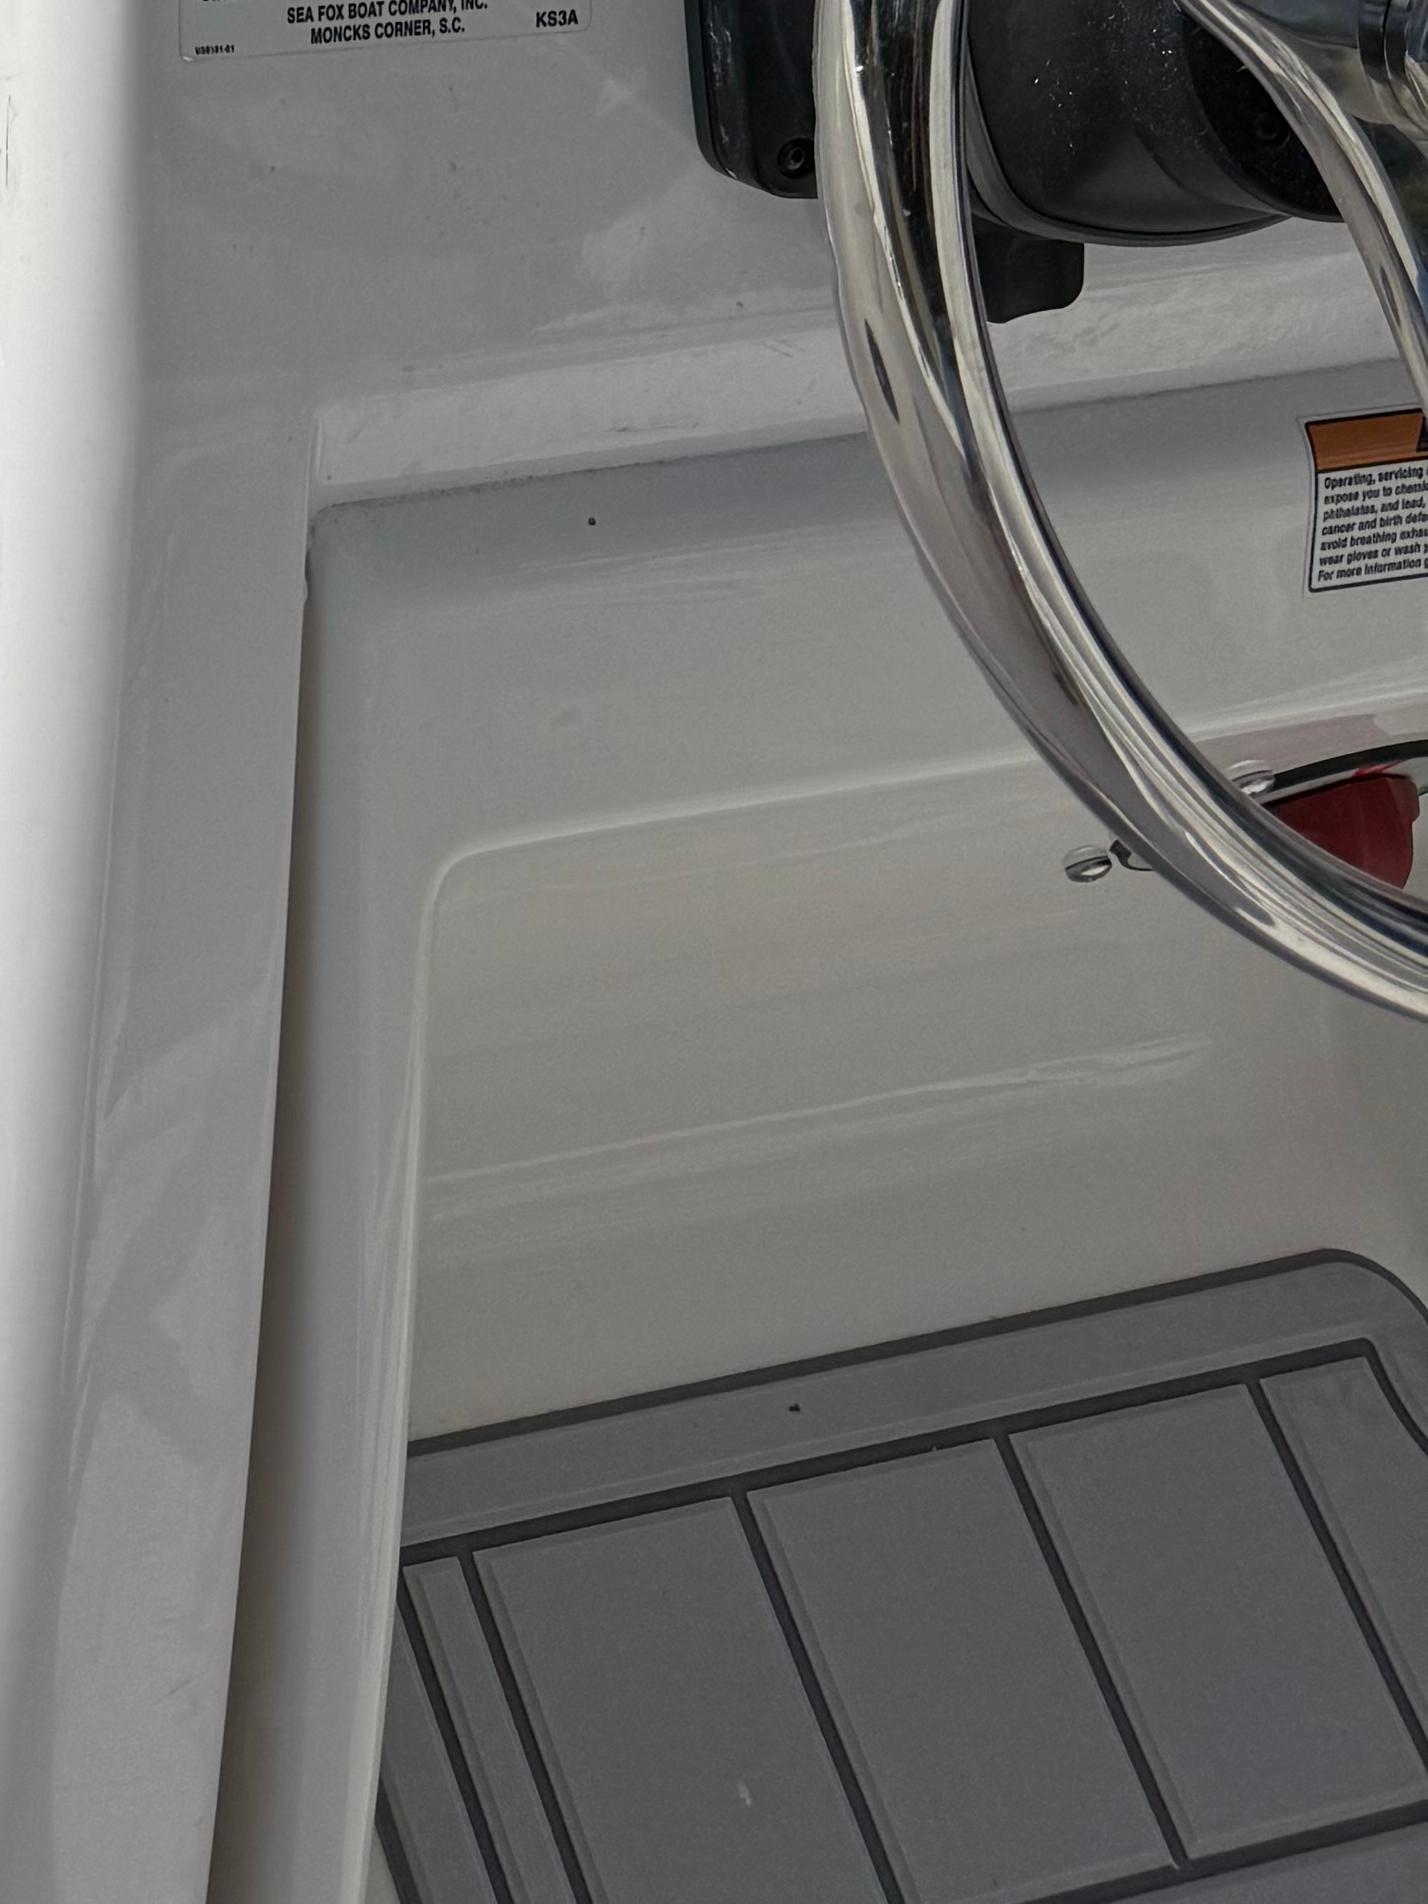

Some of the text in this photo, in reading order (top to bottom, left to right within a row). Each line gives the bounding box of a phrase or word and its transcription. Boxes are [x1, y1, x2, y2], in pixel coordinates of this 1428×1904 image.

[287, 7, 314, 25] SEA
[318, 4, 345, 22] FOX
[348, 1, 384, 20] BOAT
[535, 10, 578, 29] KS3A
[310, 16, 465, 45] MONCKS CORNER, S.C.
[1324, 473, 1376, 490] Operating,
[1324, 491, 1359, 504] expose
[1362, 489, 1380, 501] you
[1383, 486, 1392, 496] to
[1380, 500, 1399, 512] and
[1322, 523, 1355, 535] cancer
[1358, 519, 1376, 530] and
[1380, 515, 1403, 527] birth
[1321, 538, 1347, 550] avoid
[1350, 532, 1397, 547] breathing
[1319, 554, 1344, 566] wear
[1347, 550, 1378, 564] gloves
[1381, 548, 1391, 557] or
[1394, 542, 1421, 555] wash
[1318, 570, 1334, 581] For
[1336, 567, 1362, 578] more
[1365, 559, 1421, 575] information
